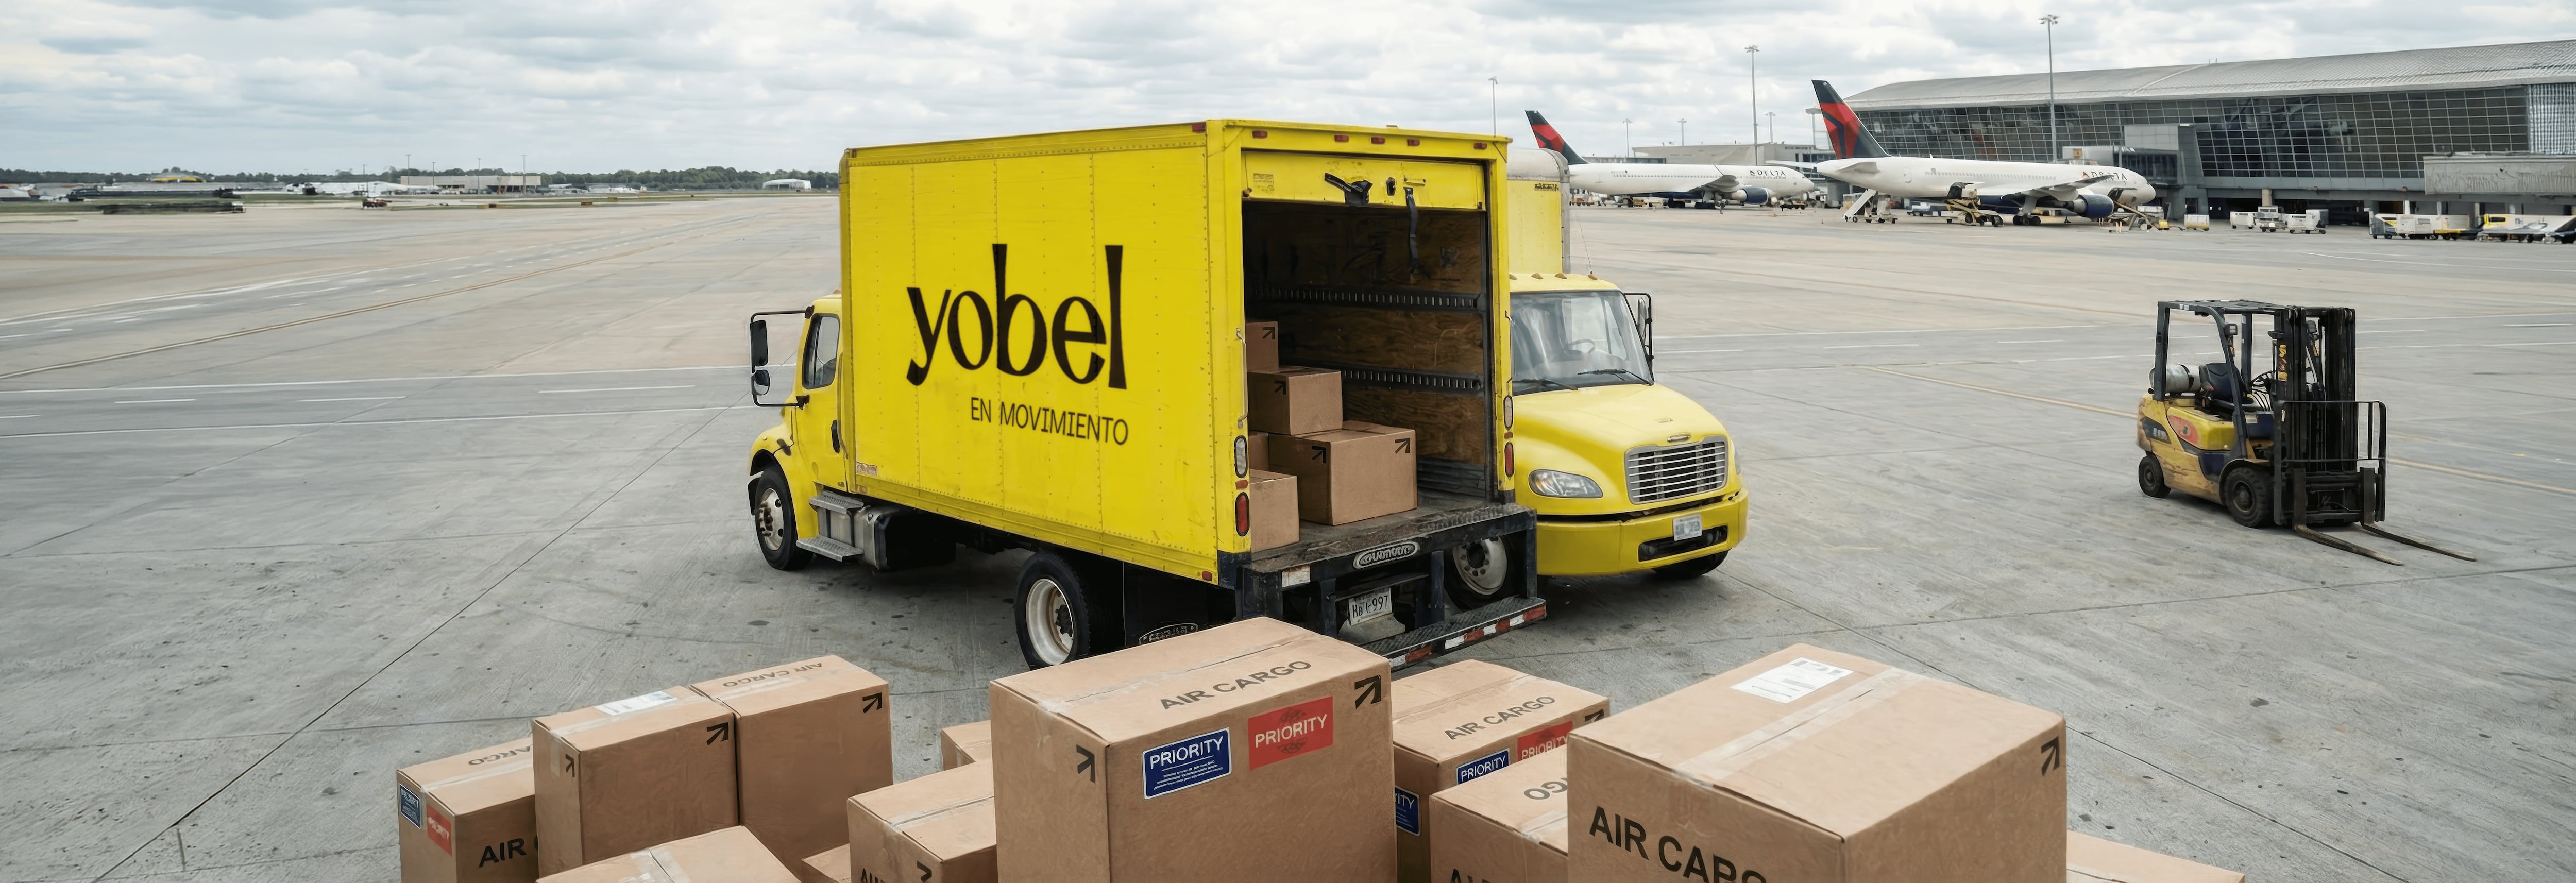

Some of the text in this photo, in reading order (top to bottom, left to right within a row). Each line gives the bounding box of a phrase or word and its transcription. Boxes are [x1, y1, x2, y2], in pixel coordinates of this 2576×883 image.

[906, 244, 1127, 389] yobel
[971, 397, 1128, 445] EN MOVIMIENTO
[722, 670, 790, 687] CARGO
[1160, 661, 1311, 710] AIR CARGO
[1255, 714, 1327, 748] PRIORITY
[1444, 696, 1555, 740] AIR CARGO
[468, 745, 531, 766] ARGO
[1150, 736, 1223, 770] PRIORITY
[1461, 755, 1506, 782] PRIORITY
[1589, 805, 1649, 860] AIR
[479, 838, 527, 868] AIR
